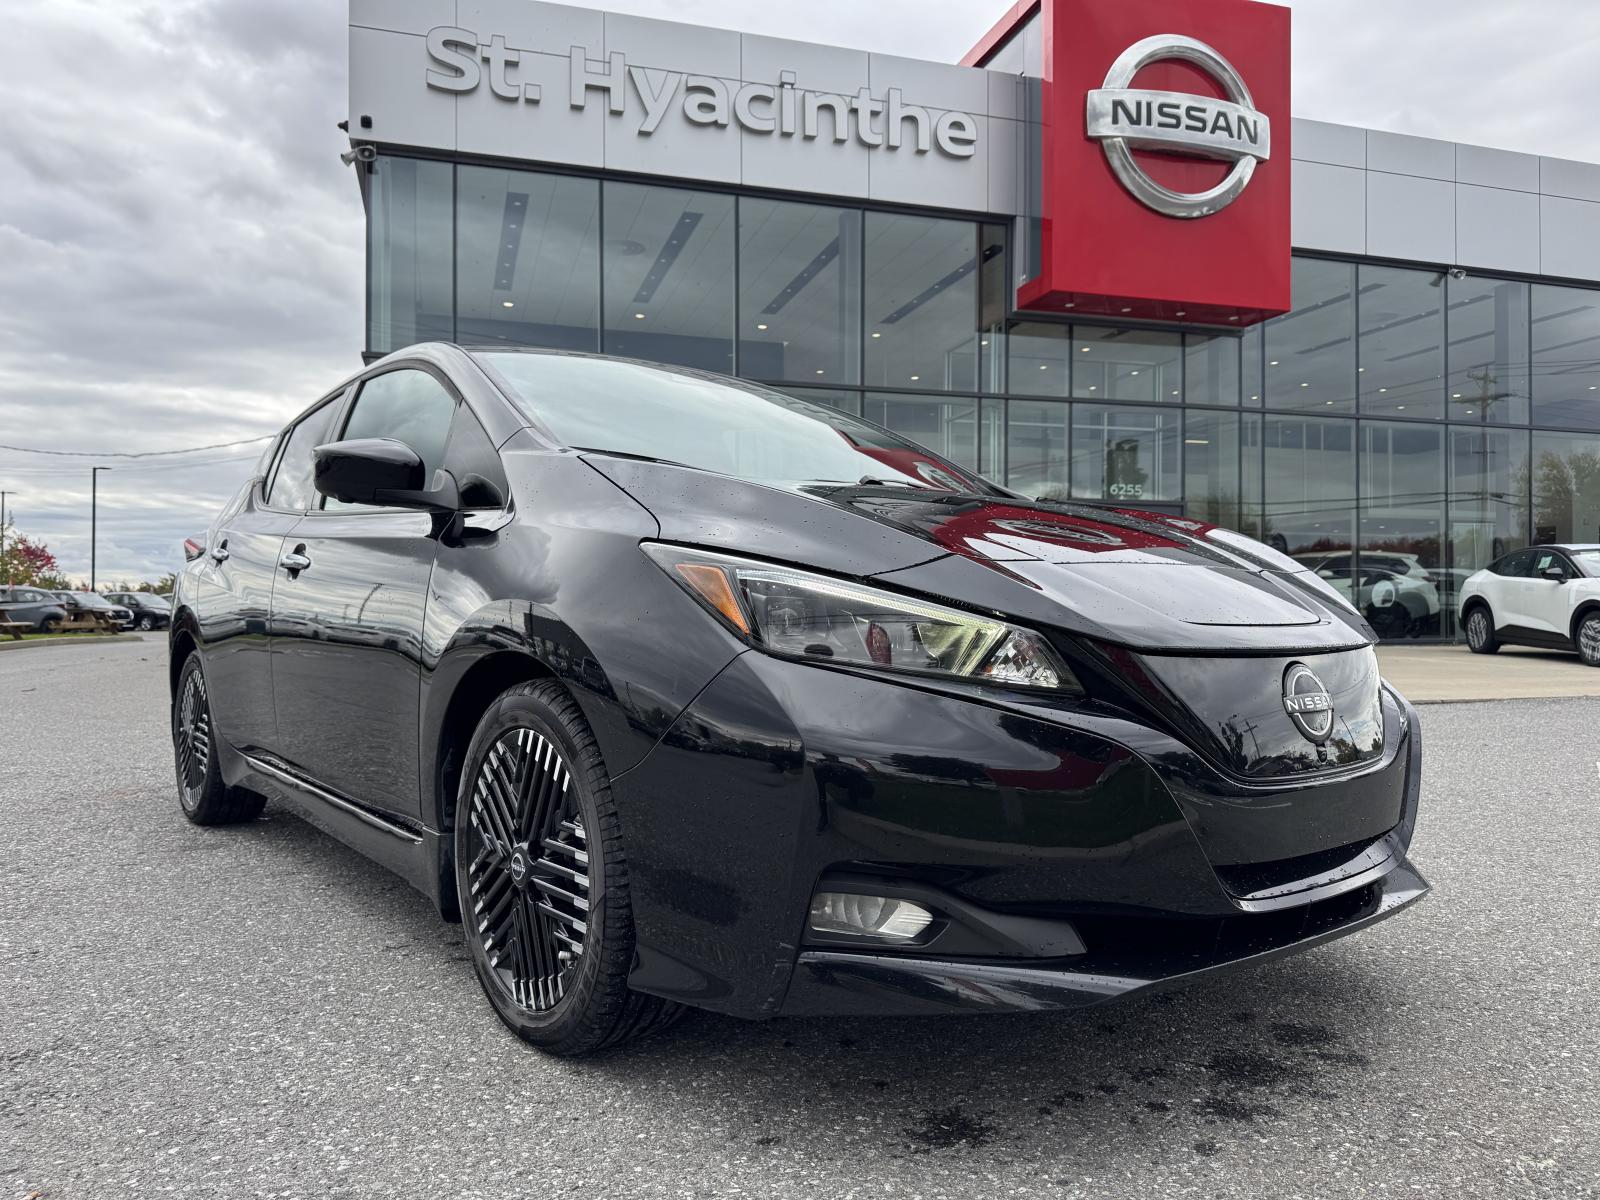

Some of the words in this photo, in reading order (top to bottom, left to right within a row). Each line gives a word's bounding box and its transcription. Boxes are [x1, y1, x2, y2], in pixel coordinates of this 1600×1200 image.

[426, 26, 541, 104] St.
[569, 45, 977, 159] Hyacinthe
[1111, 99, 1258, 145] NISSAN
[1110, 483, 1143, 496] 6255
